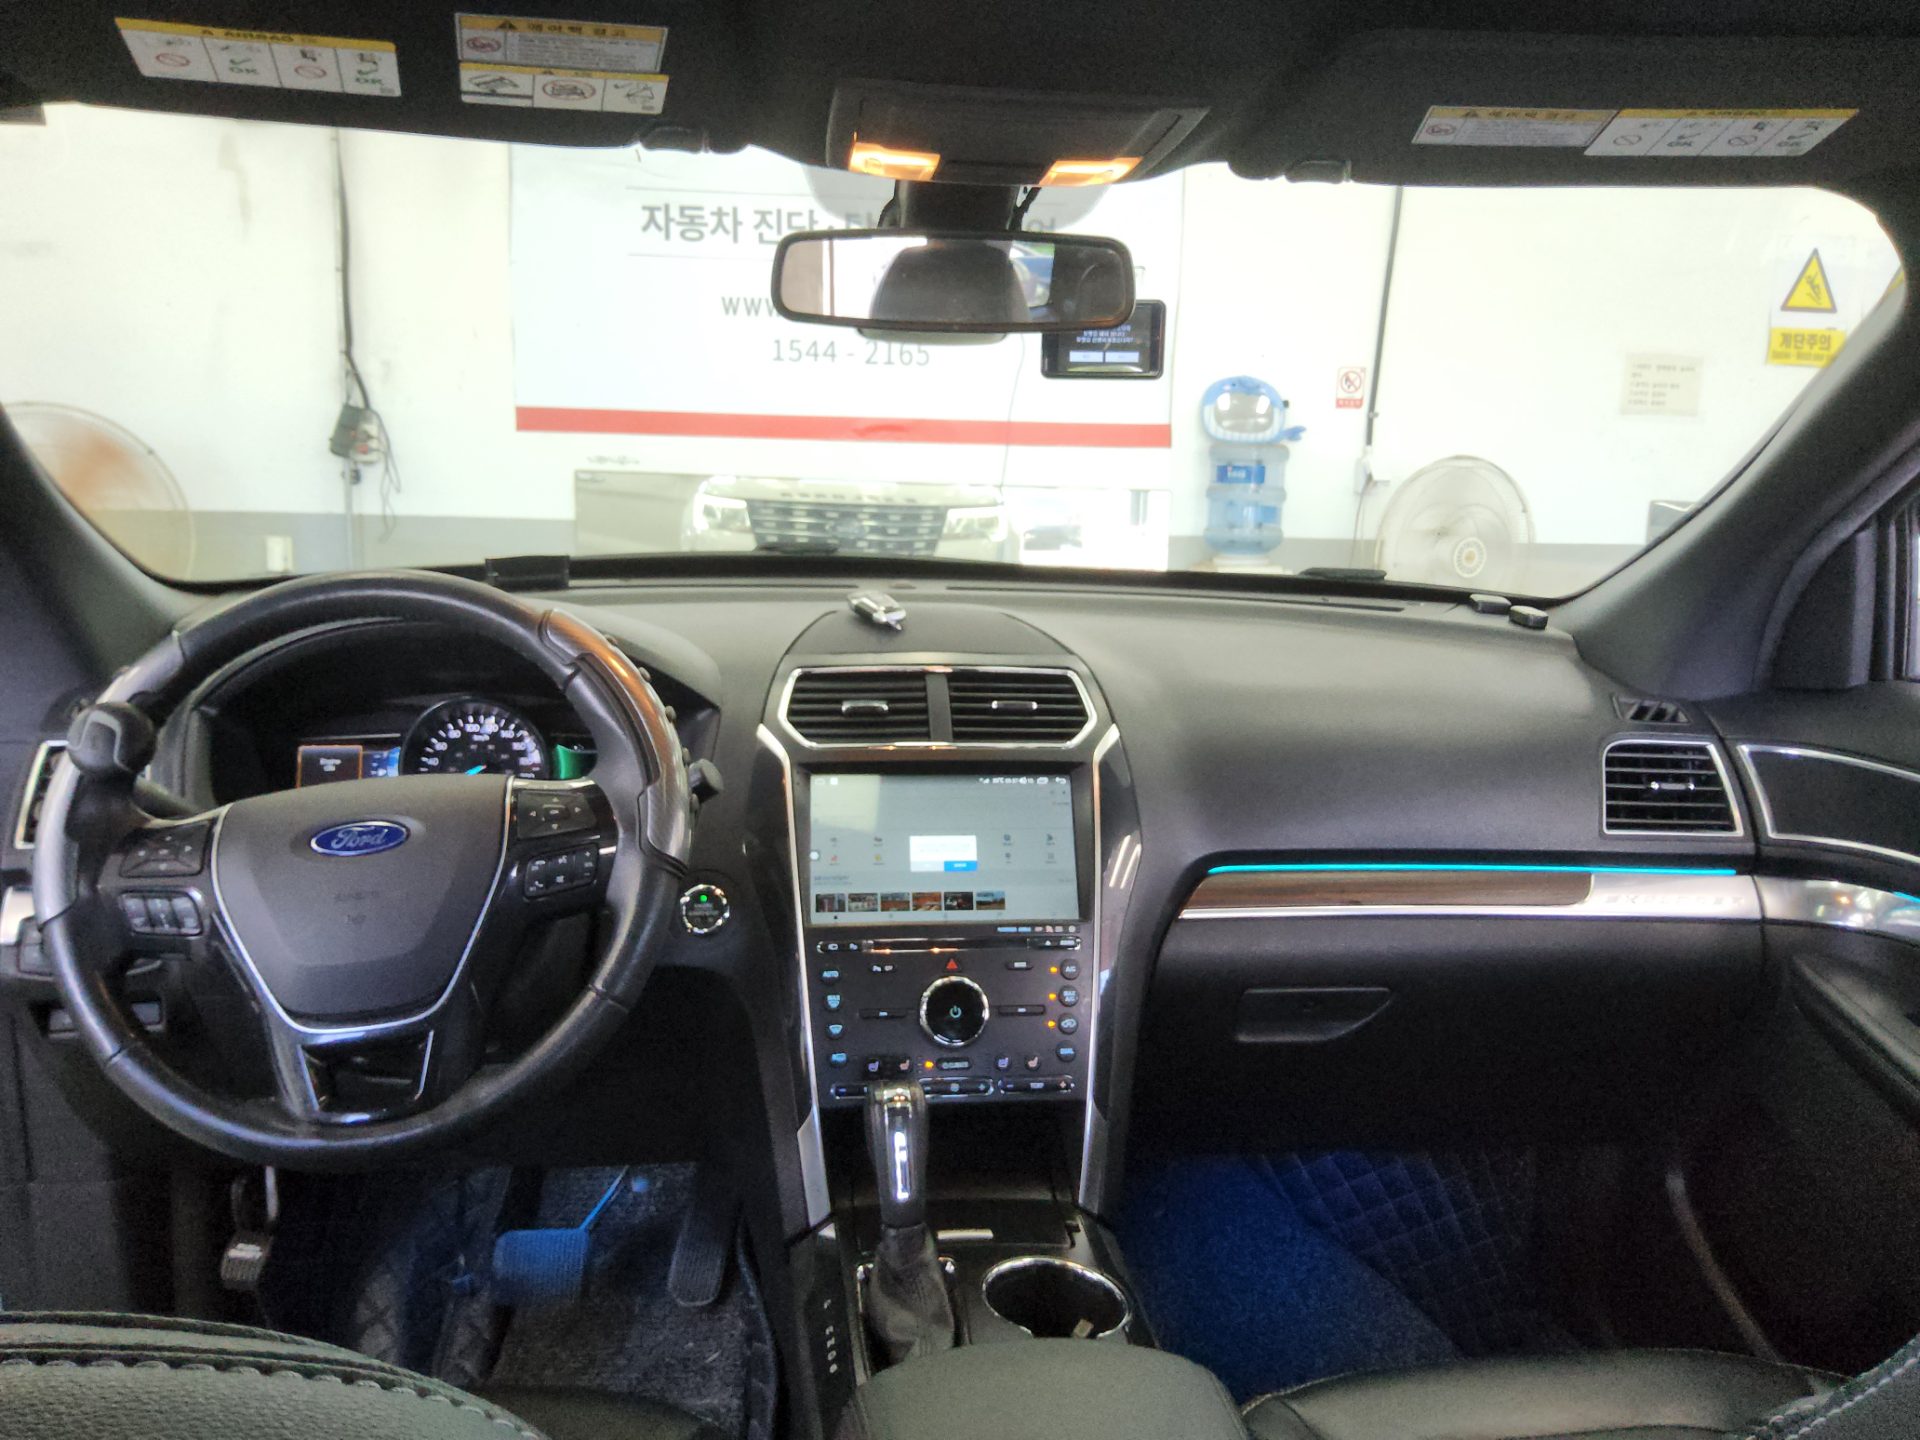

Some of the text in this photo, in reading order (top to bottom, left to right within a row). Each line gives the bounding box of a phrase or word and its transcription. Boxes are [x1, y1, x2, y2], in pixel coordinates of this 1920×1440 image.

[641, 203, 743, 244] 자동차
[772, 339, 837, 362] 1544
[865, 341, 930, 366] 2165
[331, 827, 389, 849] Ford
